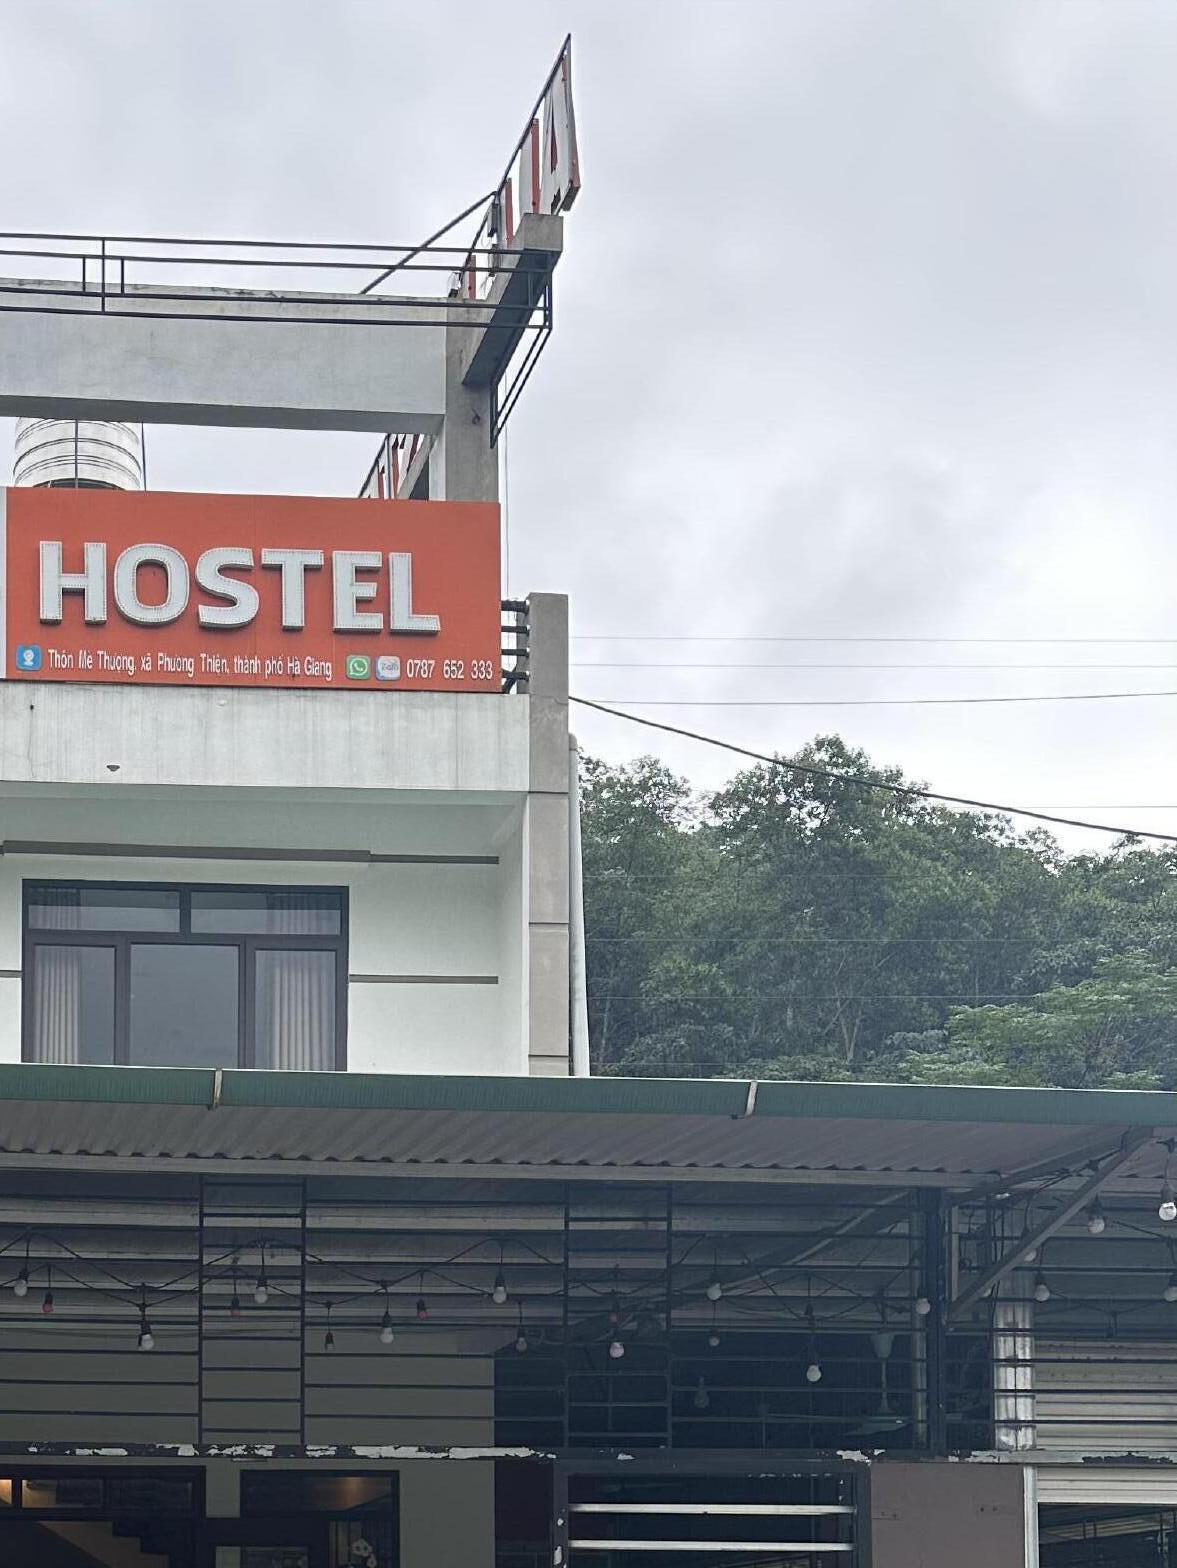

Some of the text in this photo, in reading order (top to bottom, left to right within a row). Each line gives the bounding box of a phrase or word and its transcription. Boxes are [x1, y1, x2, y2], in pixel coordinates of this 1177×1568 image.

[38, 540, 441, 634] HOSTEL
[233, 655, 261, 673] thành
[265, 653, 283, 678] phố
[288, 656, 301, 674] Hà
[304, 656, 333, 681] Giang
[406, 659, 493, 680] 0787 652 333
